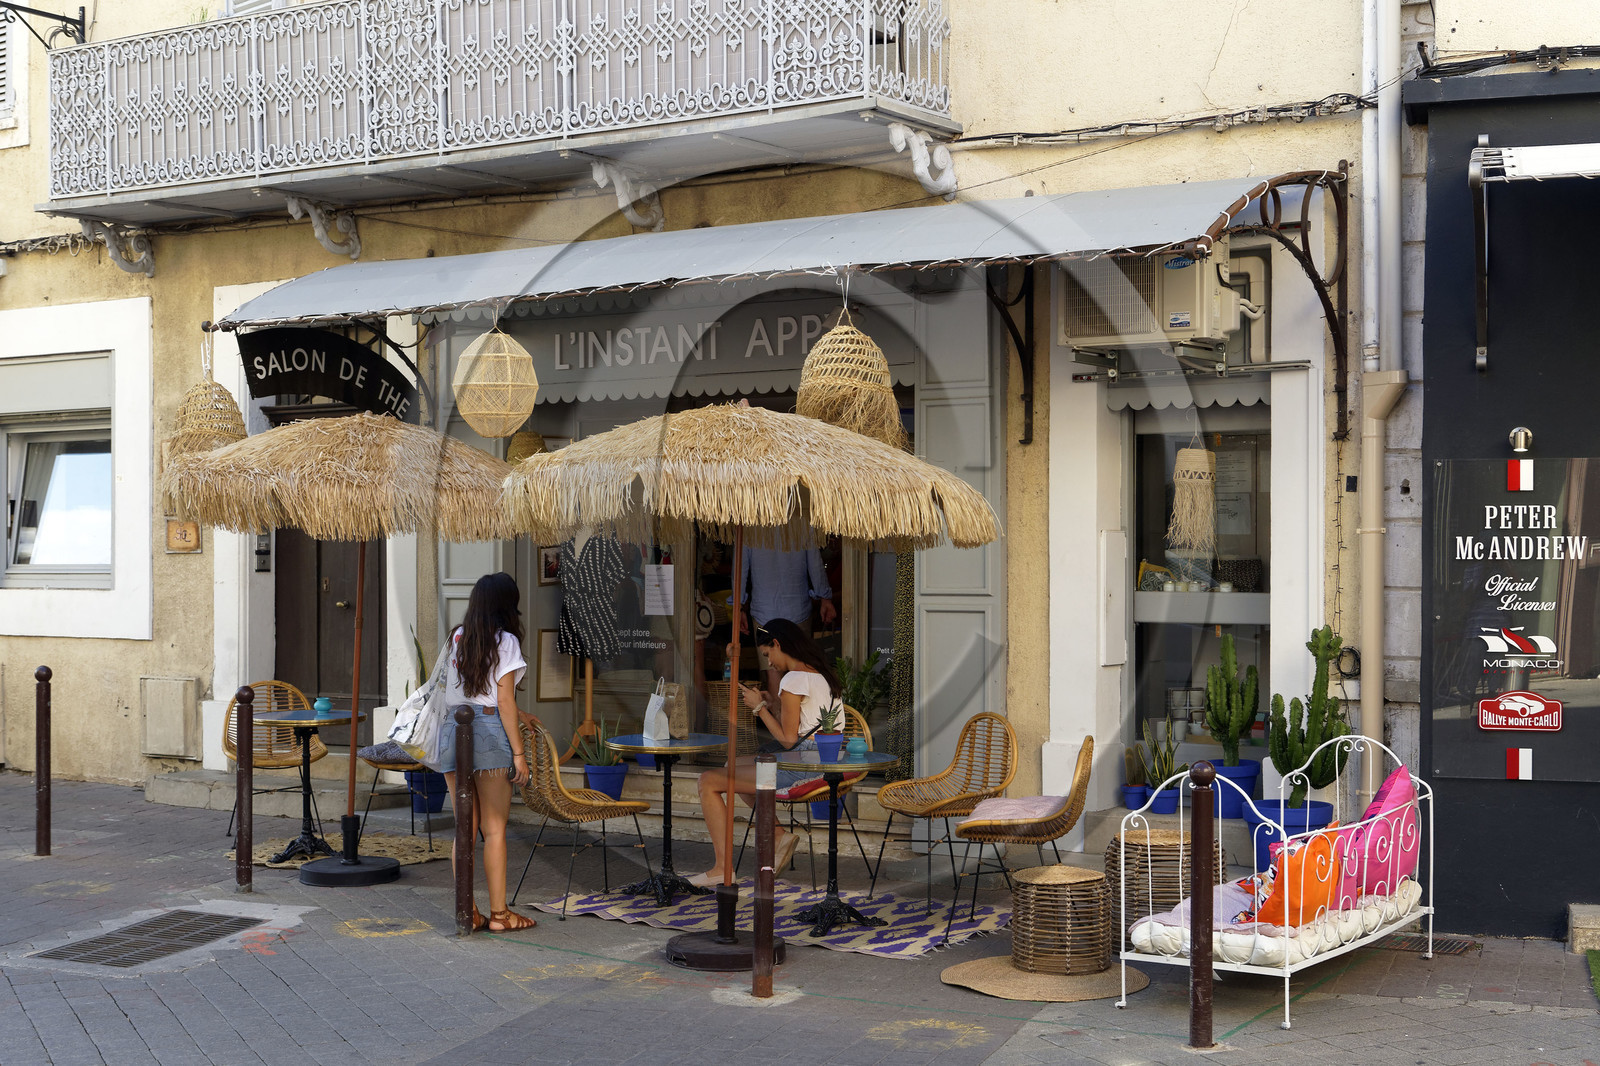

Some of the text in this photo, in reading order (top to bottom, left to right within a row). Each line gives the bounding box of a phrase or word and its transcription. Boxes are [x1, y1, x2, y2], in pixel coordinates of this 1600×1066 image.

[554, 322, 722, 370] L'INSTANT
[254, 347, 411, 419] SALON DE THE
[1484, 505, 1557, 529] PETER
[1484, 574, 1539, 597] Official
[1496, 593, 1557, 611] Licenses
[632, 629, 650, 637] store
[633, 639, 667, 650] intérieure
[1482, 709, 1559, 727] RALLYE MONTE-CARLO
